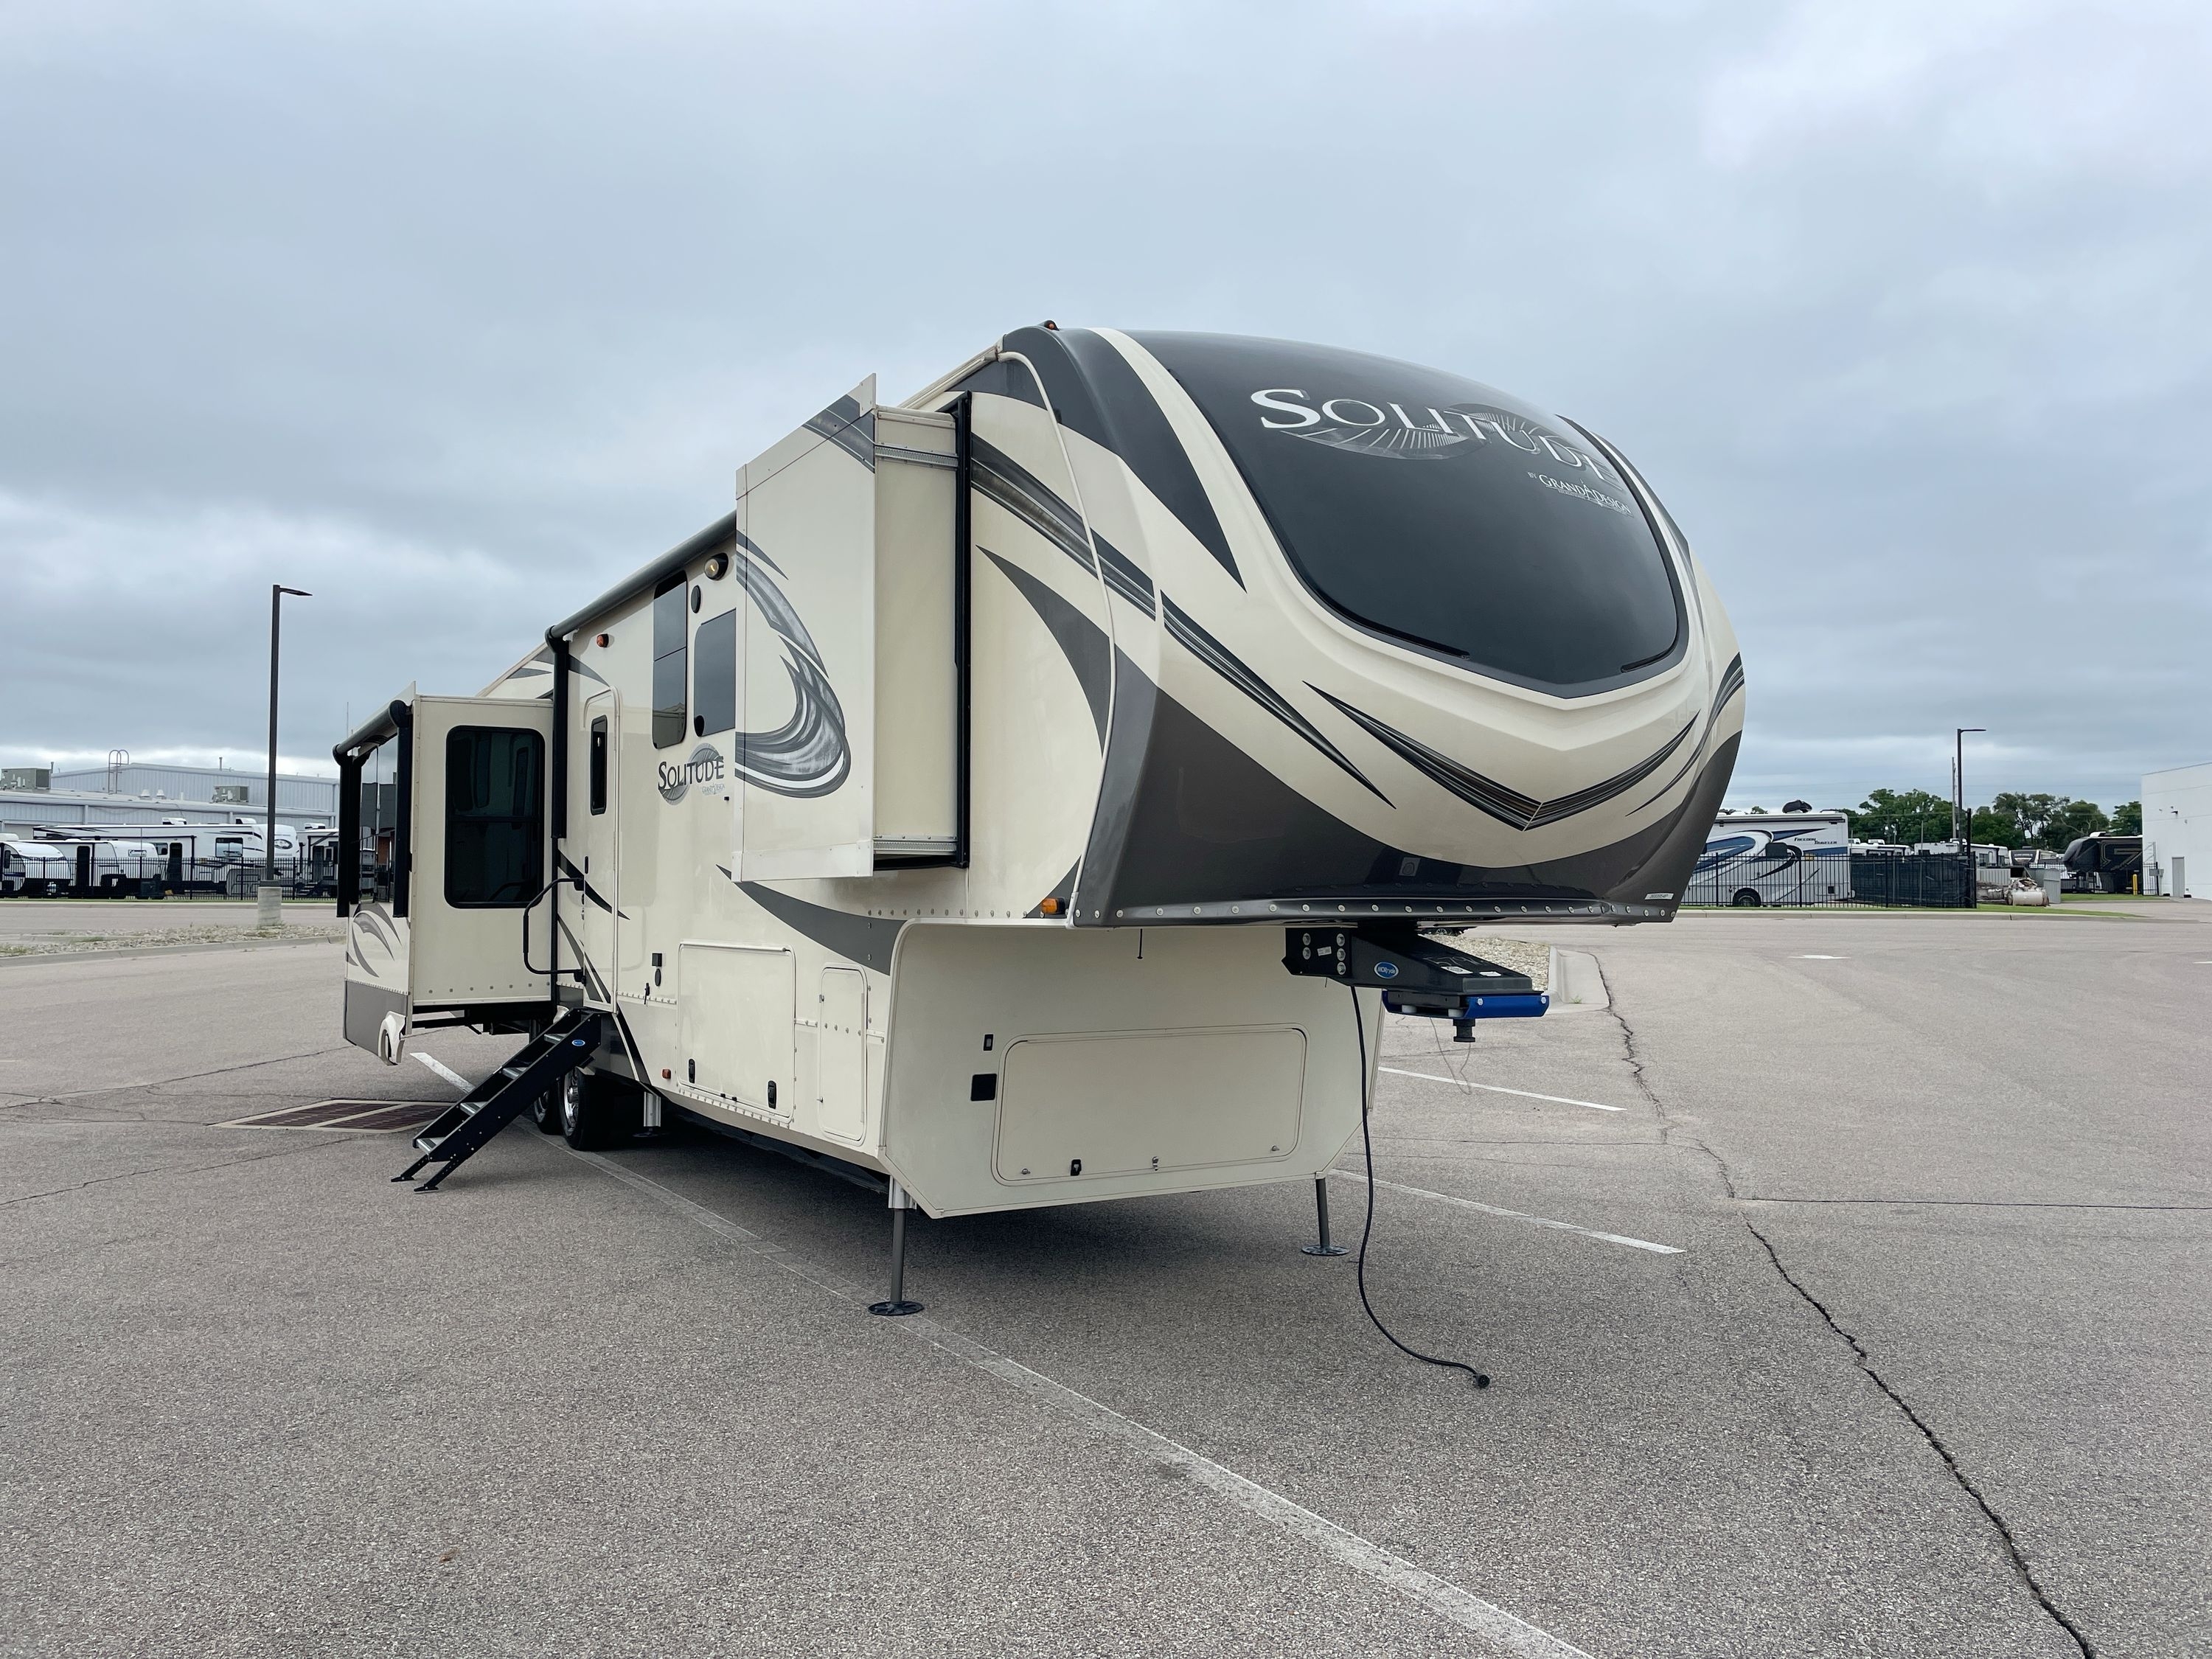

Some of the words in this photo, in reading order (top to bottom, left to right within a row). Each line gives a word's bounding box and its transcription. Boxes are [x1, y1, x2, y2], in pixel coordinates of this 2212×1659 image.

[1251, 389, 1622, 490] SOLITUDE
[1527, 471, 1537, 479] BY
[1539, 474, 1586, 495] GRAND
[1591, 488, 1632, 514] DESIGN
[658, 755, 725, 790] SOLITUDE
